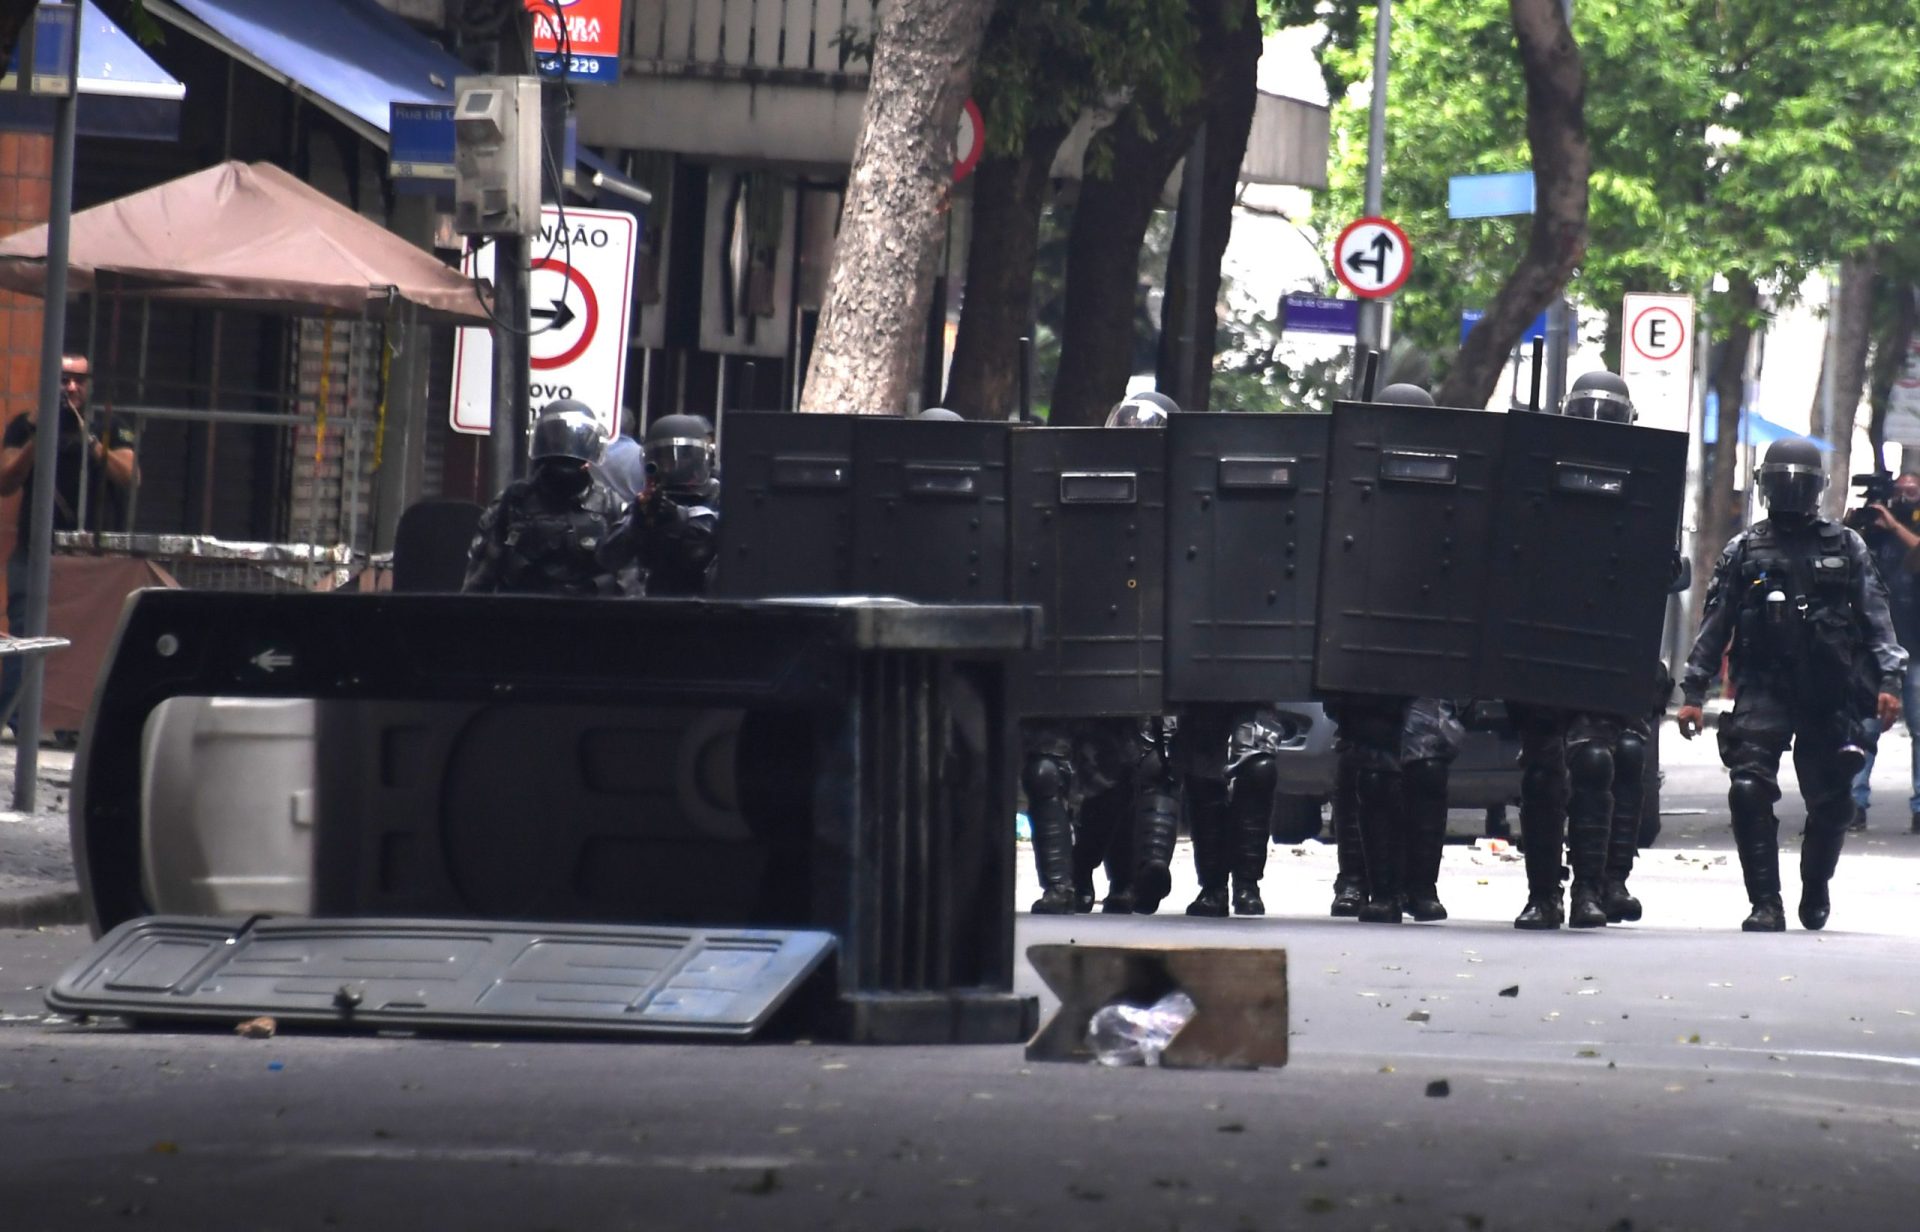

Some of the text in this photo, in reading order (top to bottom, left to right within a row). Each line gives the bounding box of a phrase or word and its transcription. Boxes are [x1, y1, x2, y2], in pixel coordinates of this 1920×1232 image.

[534, 13, 600, 33] ULTURA
[534, 26, 600, 43] INGESA
[532, 223, 608, 250] NÇÃO
[1650, 319, 1666, 348] E
[530, 384, 573, 400] ovo
